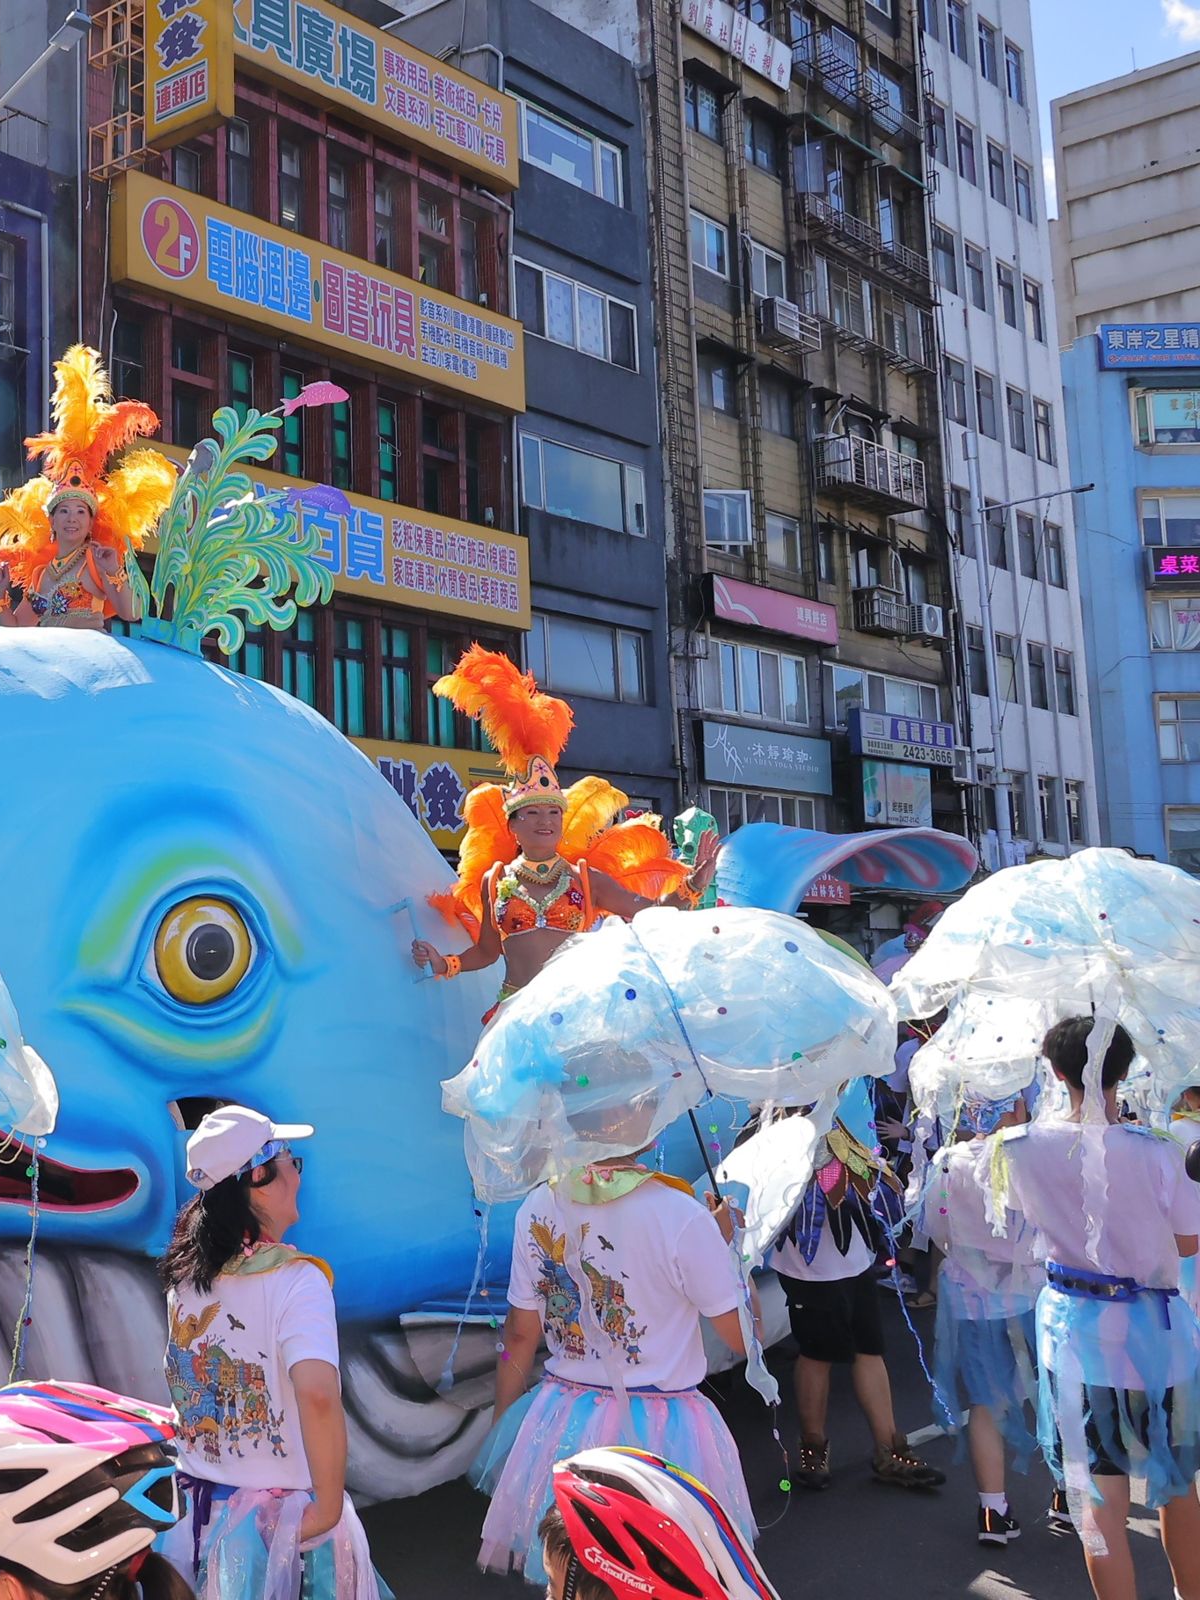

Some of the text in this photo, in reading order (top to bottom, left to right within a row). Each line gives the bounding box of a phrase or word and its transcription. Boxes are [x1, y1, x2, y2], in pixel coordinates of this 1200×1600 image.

[233, 0, 377, 103] 具廣場
[156, 70, 205, 113] 連鎖店
[155, 203, 191, 272] 2F
[1107, 328, 1199, 350] 東岸之星精
[903, 744, 953, 764] 2423-3666
